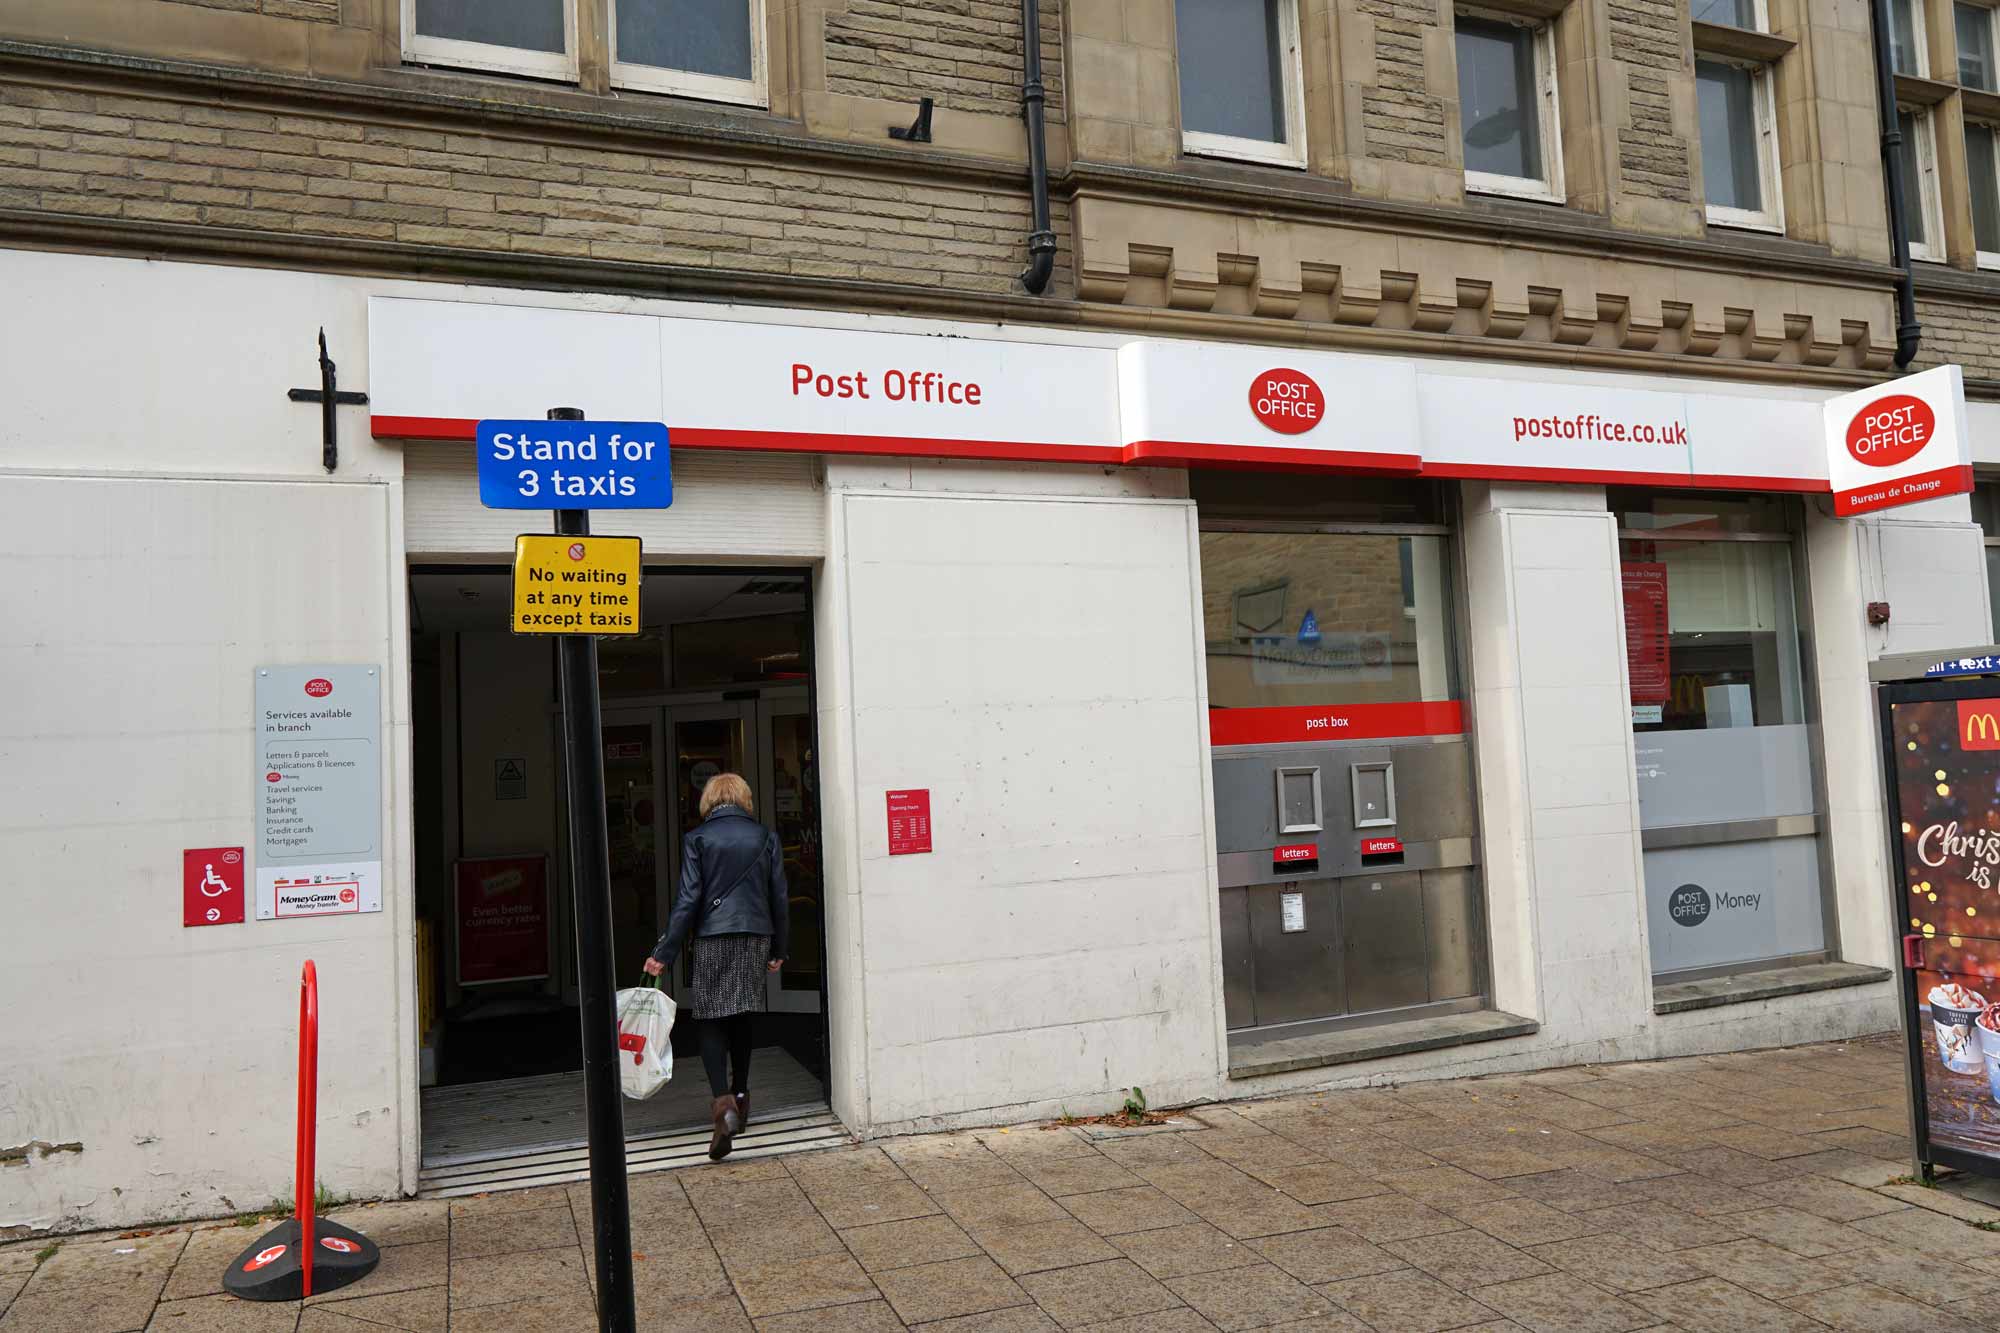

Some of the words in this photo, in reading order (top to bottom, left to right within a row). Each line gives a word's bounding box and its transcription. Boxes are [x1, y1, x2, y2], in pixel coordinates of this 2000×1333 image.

[792, 364, 869, 399] Post
[884, 369, 981, 405] Office
[1267, 380, 1309, 399] POST
[1257, 398, 1316, 418] OFFICE
[1865, 405, 1915, 433] POST
[1513, 415, 1687, 445] postoffice.co.uk
[1855, 423, 1925, 455] OFFICE
[493, 433, 596, 461] Stand
[608, 434, 656, 461] for
[518, 469, 539, 497] 3
[550, 469, 636, 496] taxis
[1850, 489, 1886, 506] Bureau
[1888, 488, 1900, 498] de
[1903, 480, 1941, 495] Change
[529, 568, 554, 582] No
[561, 568, 627, 586] waiting
[526, 592, 544, 605] at
[551, 594, 583, 608] any
[590, 592, 629, 606] time
[521, 612, 583, 628] except
[589, 612, 632, 626] taxis
[265, 710, 307, 720] Services
[310, 708, 352, 719] available
[266, 723, 275, 732] in
[277, 722, 311, 732] branch
[1306, 717, 1328, 730] post
[1331, 716, 1349, 727] box
[266, 752, 292, 760] Letters
[301, 750, 329, 760] parcels
[266, 762, 315, 771] Applications
[266, 785, 290, 793] Travel
[266, 796, 296, 805] Savings
[266, 806, 297, 815] Banking
[266, 827, 291, 835] Credit
[293, 825, 314, 833] cards
[266, 838, 308, 847] Mortgages
[1370, 841, 1395, 851] letters
[1917, 821, 2000, 867] Chris
[1282, 848, 1309, 859] letters
[1965, 861, 1991, 889] is
[280, 894, 336, 905] MoneyGram
[1678, 892, 1702, 904] POST
[1715, 892, 1761, 911] Money
[1673, 903, 1707, 918] OFFICE
